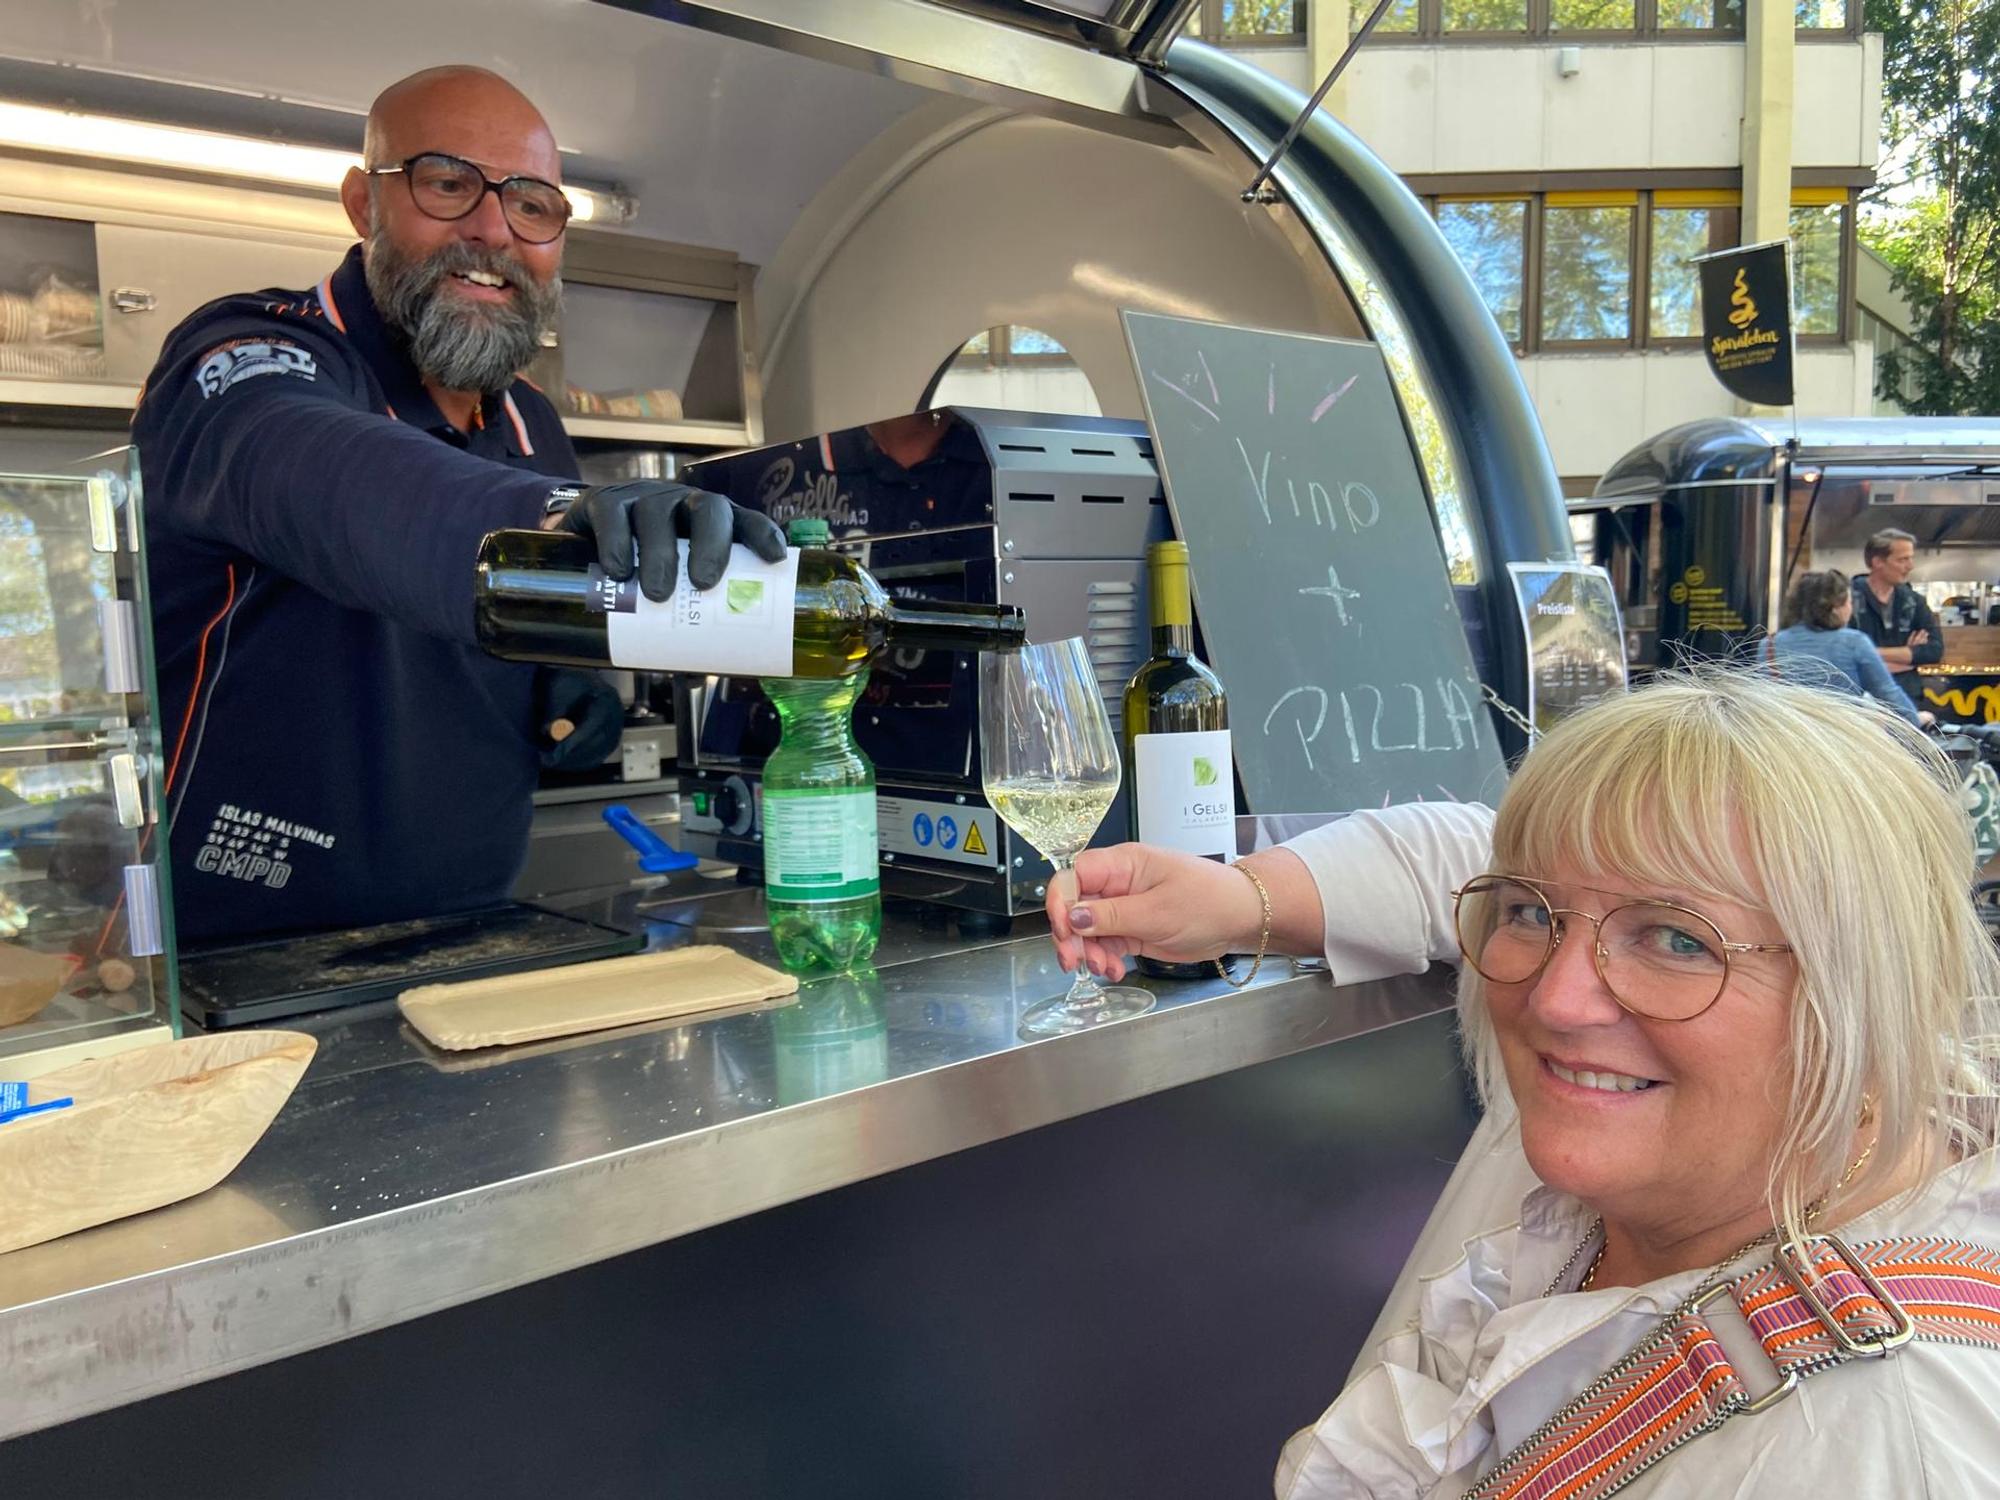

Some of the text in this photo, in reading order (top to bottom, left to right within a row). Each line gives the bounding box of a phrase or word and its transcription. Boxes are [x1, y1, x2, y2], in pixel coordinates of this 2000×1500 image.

[1237, 436, 1379, 534] Vino
[688, 589, 701, 626] ELSI
[1264, 676, 1479, 770] PIZZA
[217, 803, 336, 849] ISLAS MALVINAS
